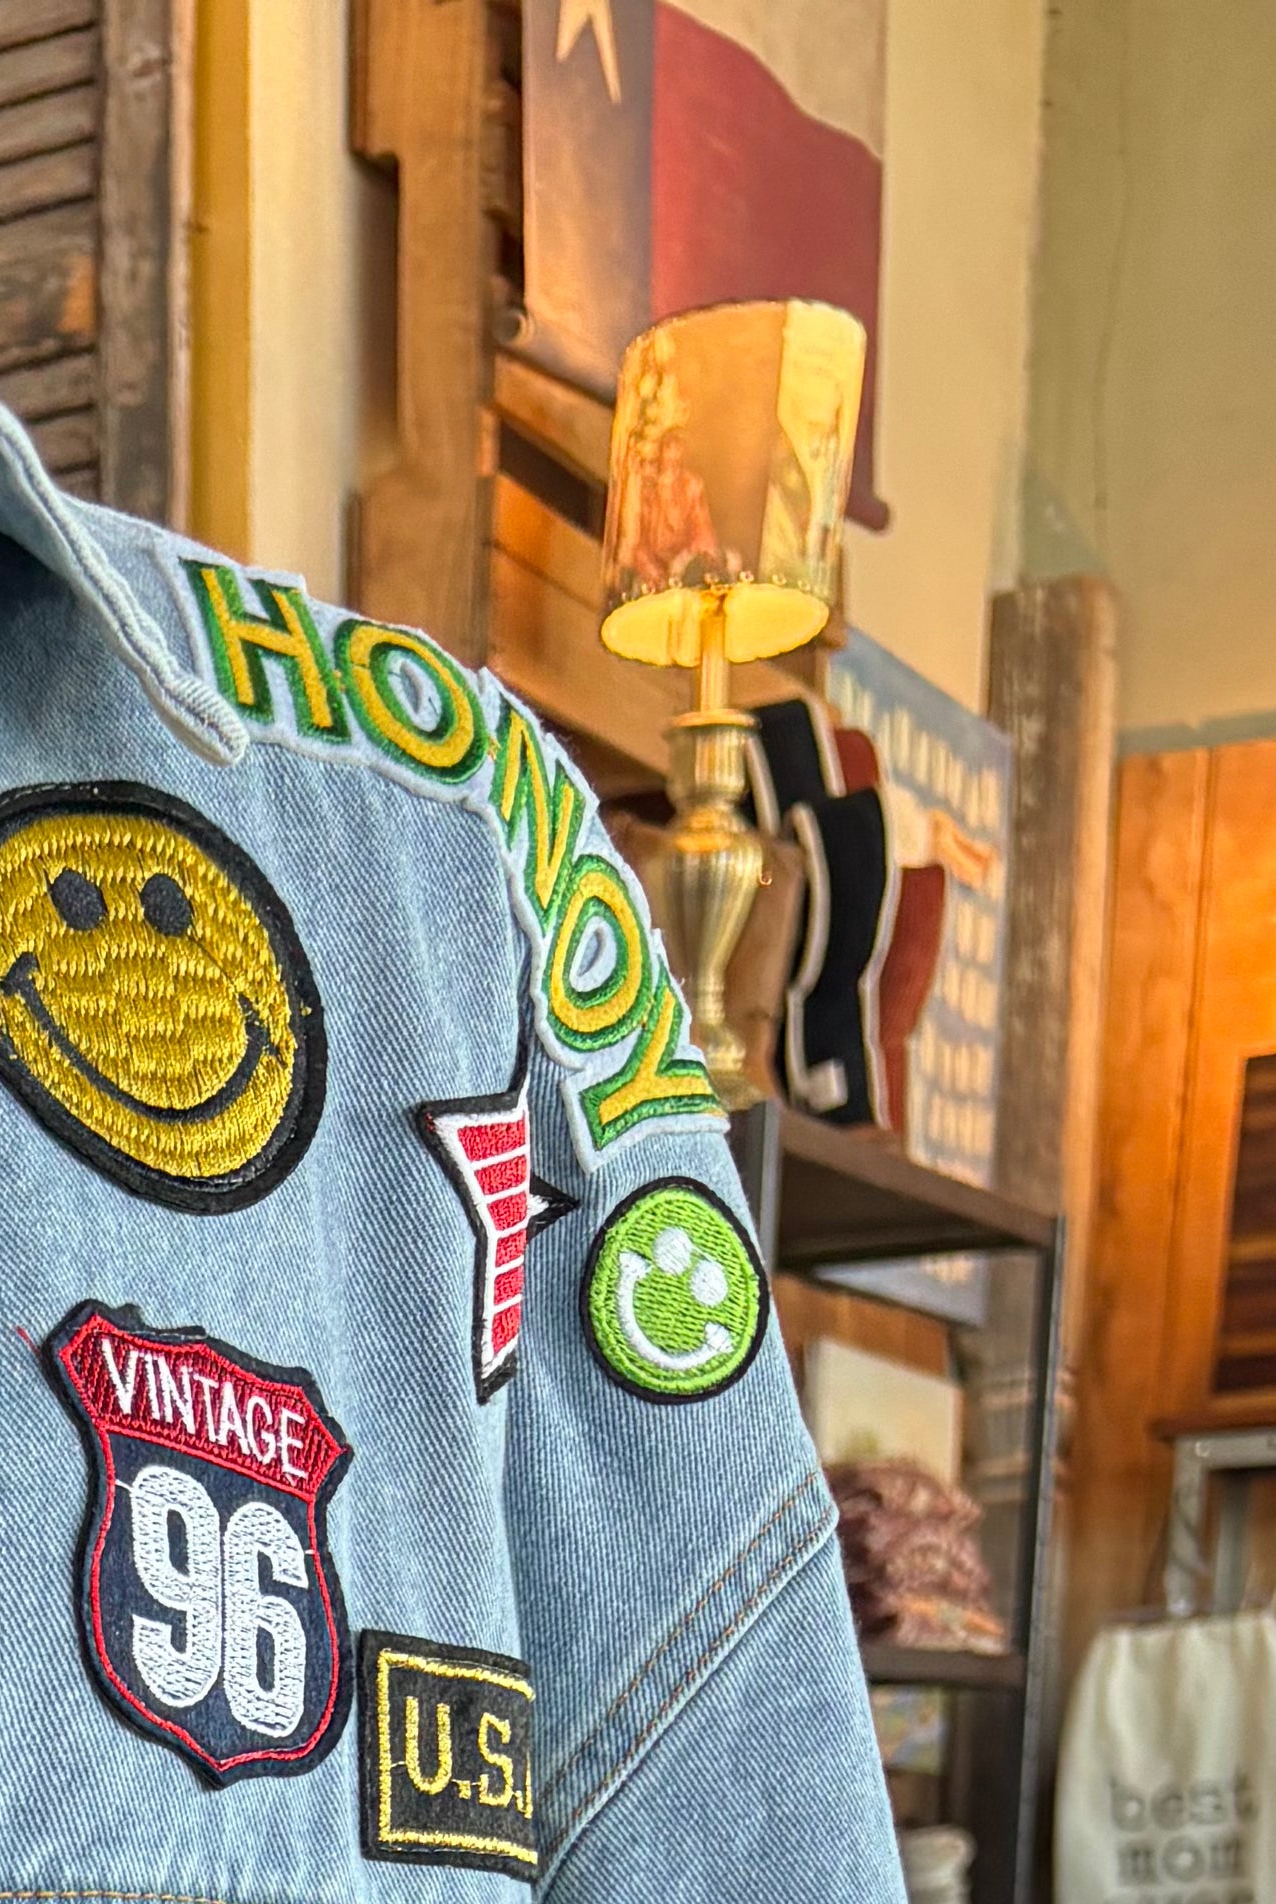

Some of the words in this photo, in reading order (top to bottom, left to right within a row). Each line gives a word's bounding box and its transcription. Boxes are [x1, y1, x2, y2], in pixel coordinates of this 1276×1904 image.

[101, 1337, 310, 1487] VINTAGE
[130, 1463, 310, 1738] 96
[1115, 1836, 1243, 1884] mom
